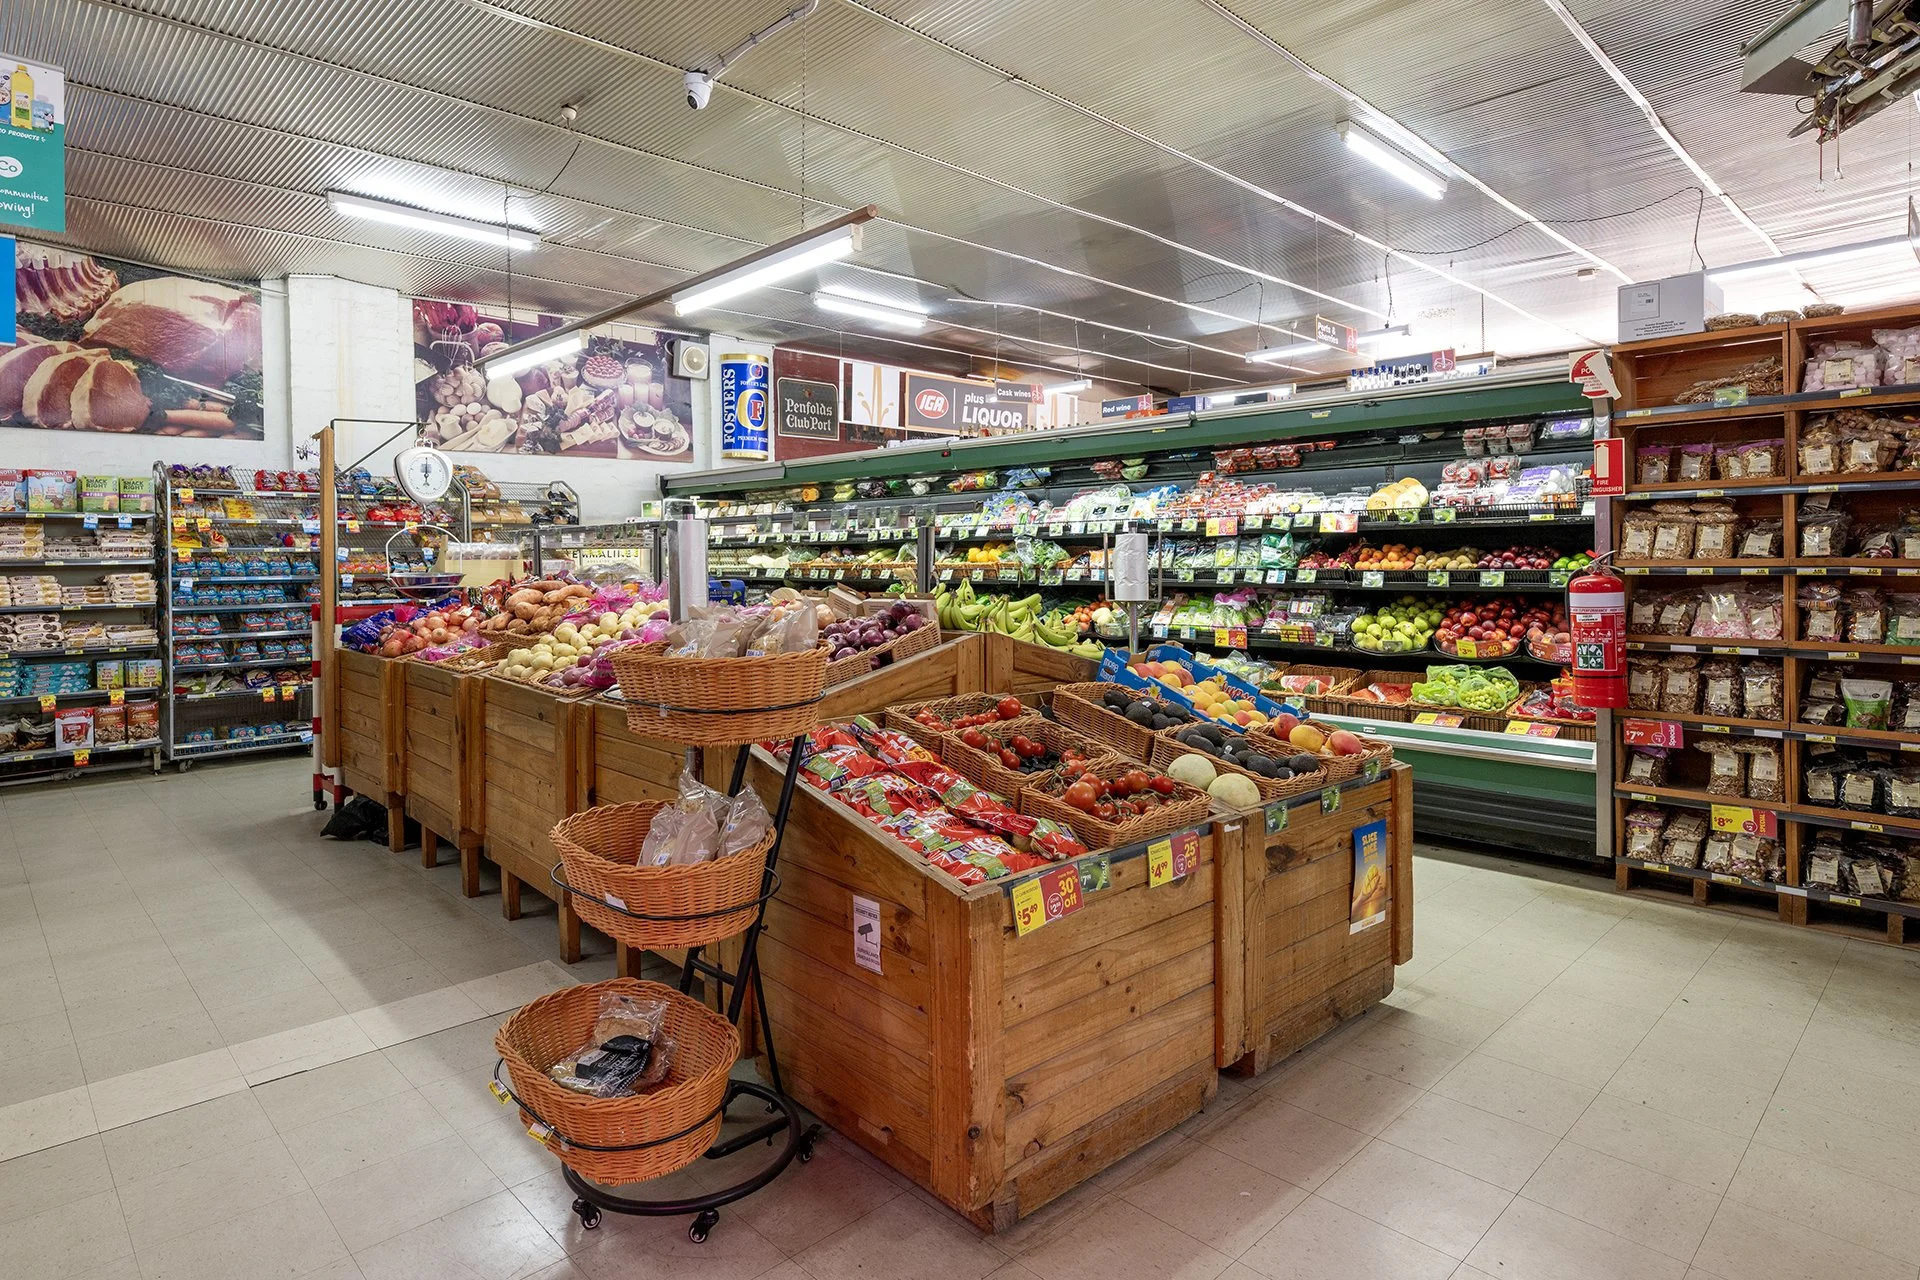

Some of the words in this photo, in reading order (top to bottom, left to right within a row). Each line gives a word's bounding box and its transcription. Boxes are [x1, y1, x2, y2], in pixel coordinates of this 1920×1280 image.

[8, 130, 40, 141] PRODUCTS
[0, 189, 48, 202] ommunities
[0, 202, 34, 218] owing!
[964, 392, 985, 404] plus
[997, 388, 1012, 396] Cask
[1012, 389, 1032, 398] wines
[723, 368, 736, 444] FOSTER'S
[784, 398, 832, 416] Penfolds
[919, 394, 945, 413] IGA
[1102, 406, 1115, 414] Red
[1116, 403, 1132, 412] wine
[786, 414, 809, 429] Club
[810, 416, 832, 432] Port
[962, 404, 1023, 428] LIQUOR
[1269, 706, 1281, 716] mo
[1187, 856, 1198, 868] off
[1058, 875, 1079, 897] 30%
[1064, 893, 1077, 908] off
